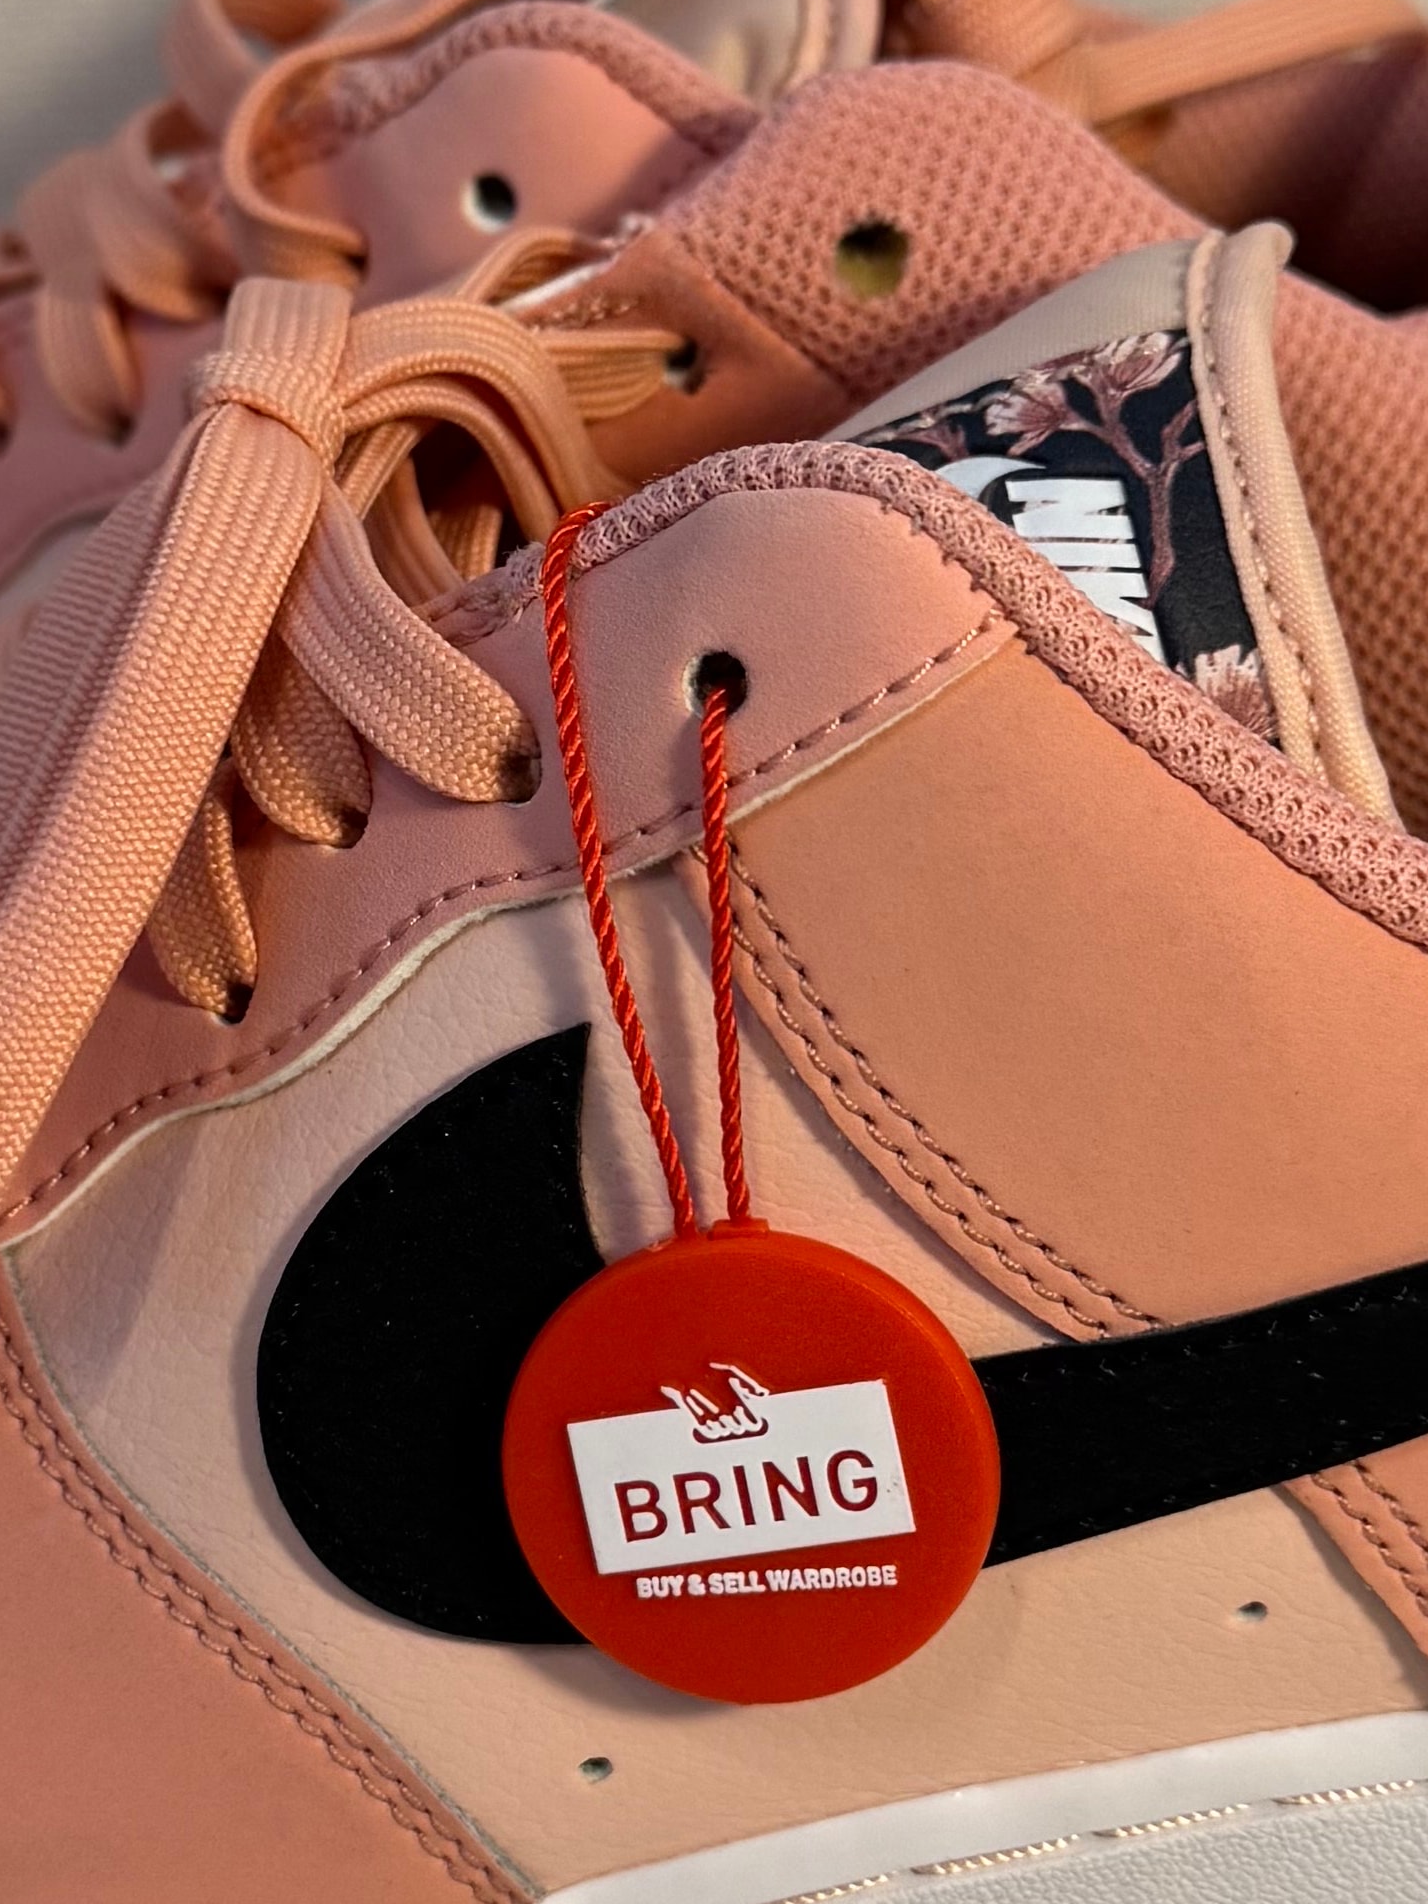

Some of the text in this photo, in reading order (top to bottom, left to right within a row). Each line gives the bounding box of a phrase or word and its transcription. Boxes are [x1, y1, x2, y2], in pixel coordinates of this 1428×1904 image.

[614, 1449, 878, 1544] BRING
[636, 1564, 898, 1598] BUY & SELL WARDROBE
